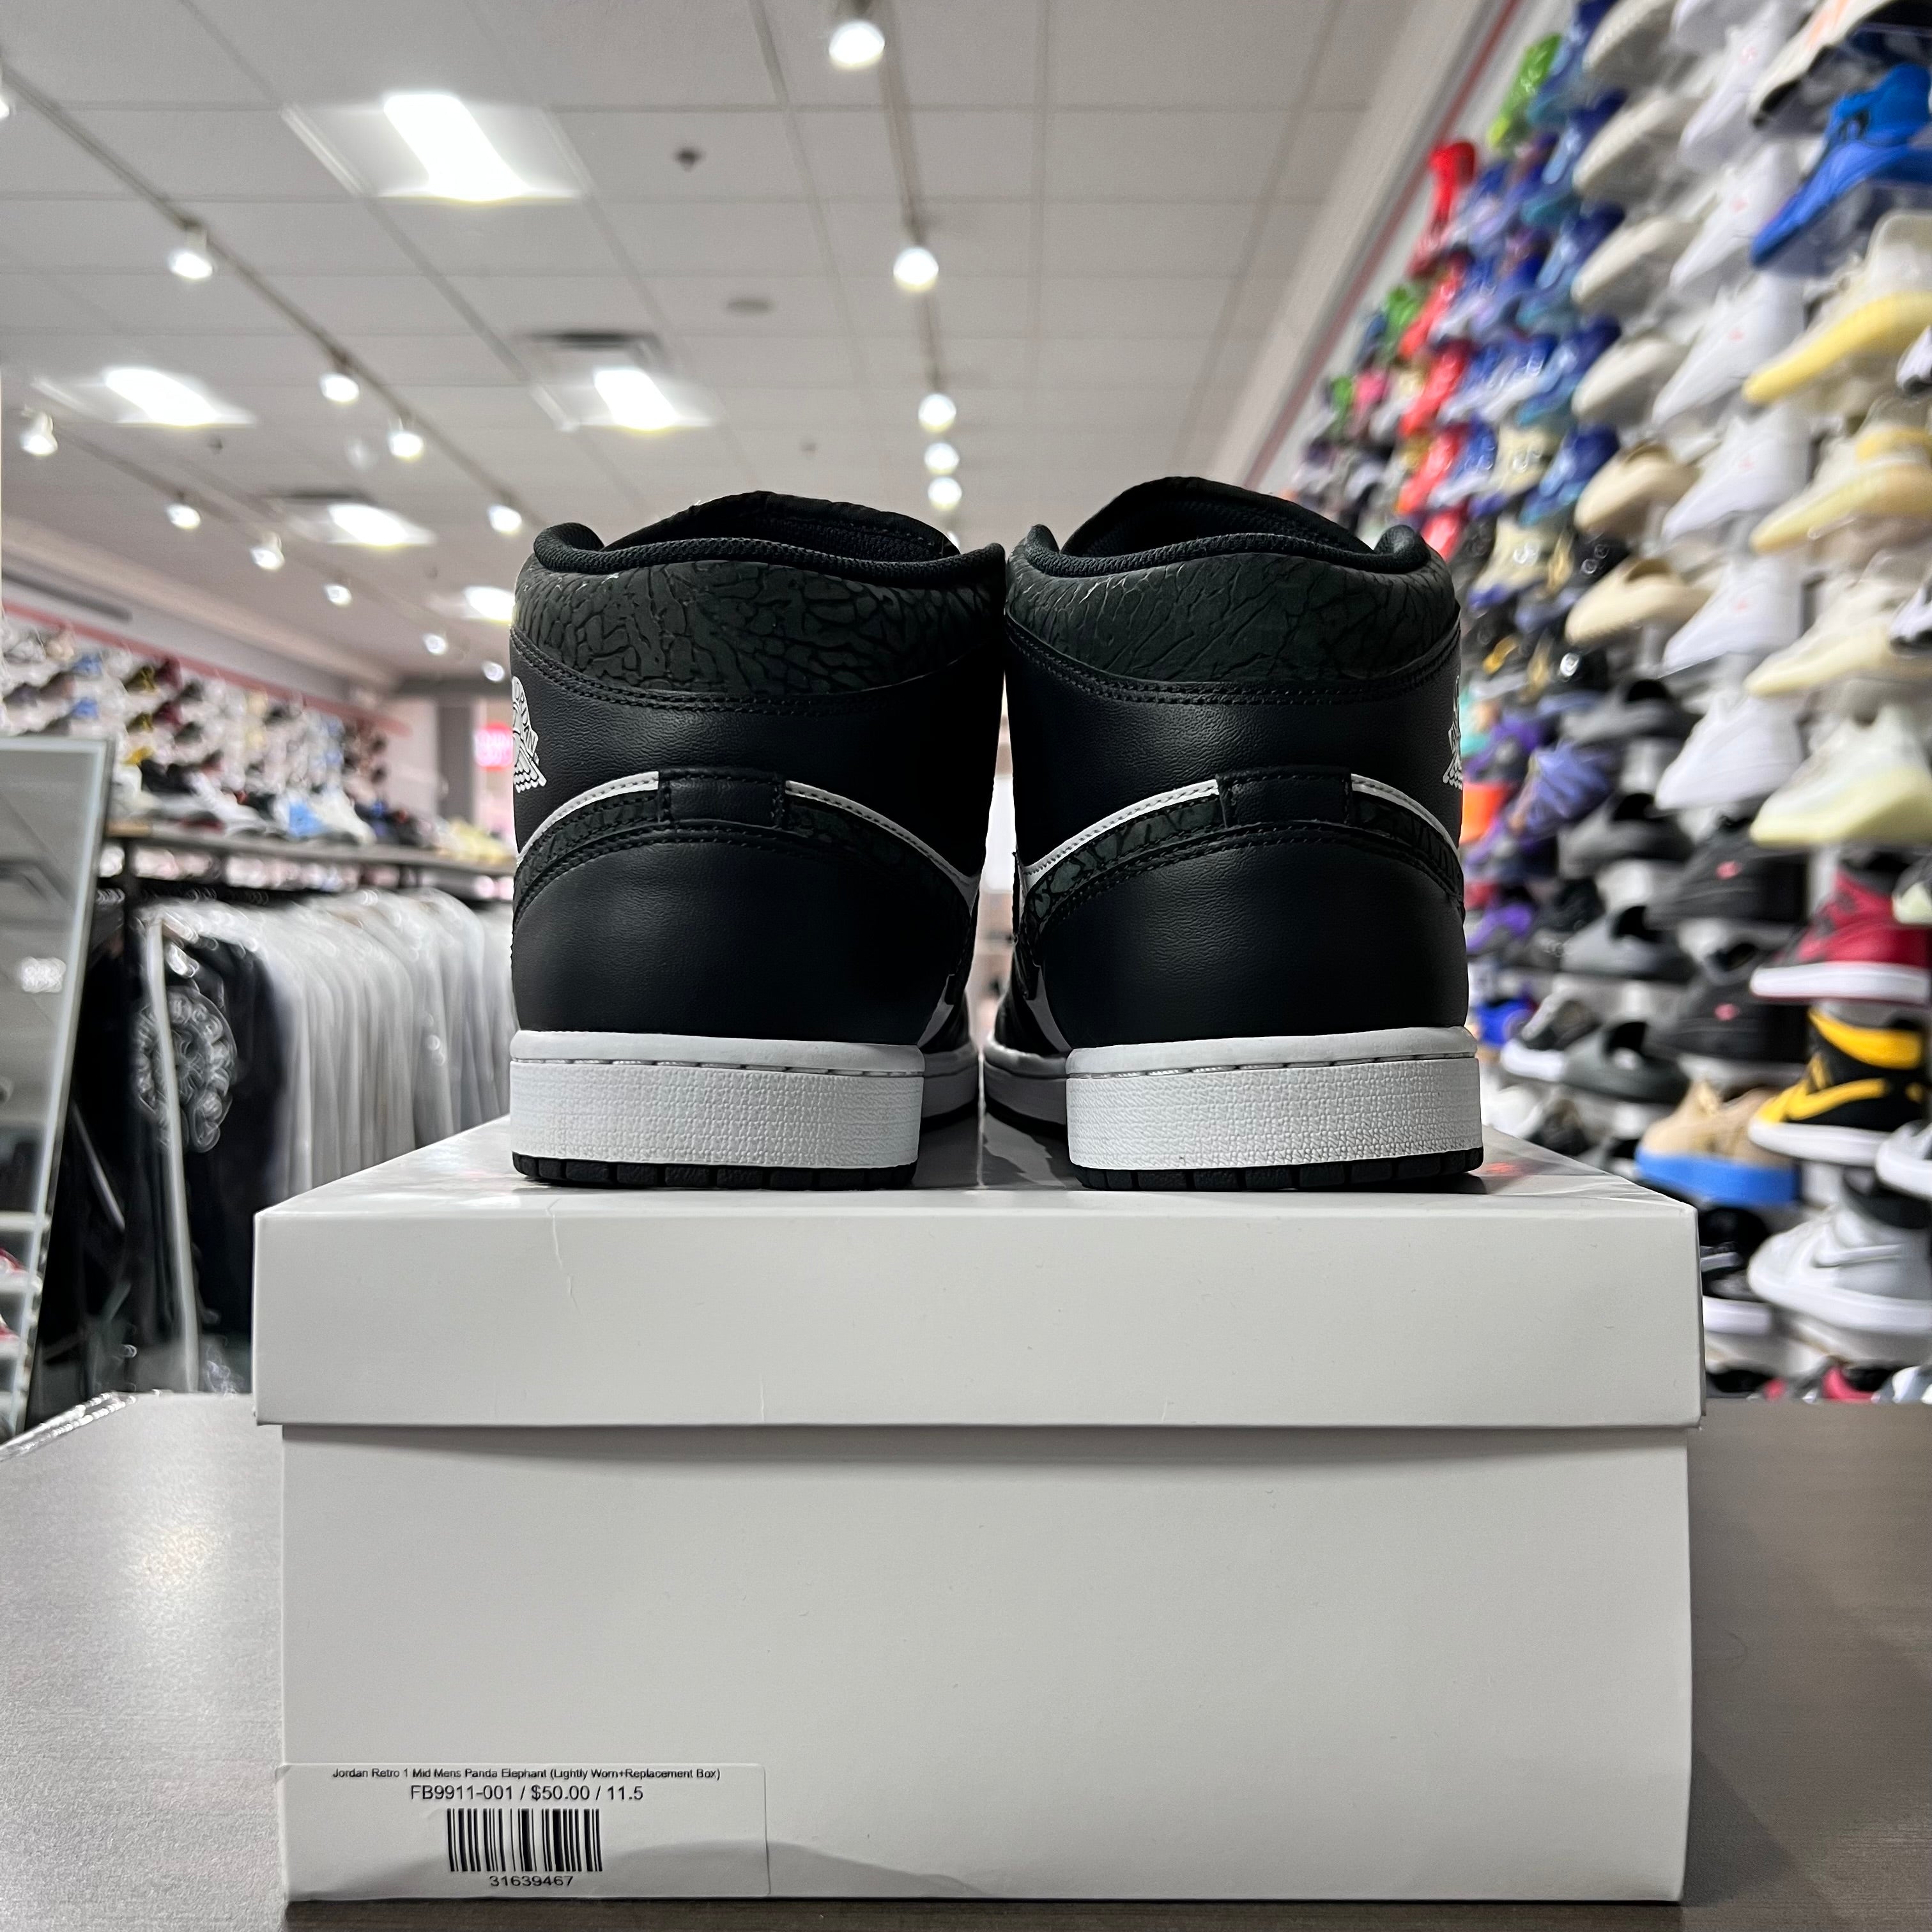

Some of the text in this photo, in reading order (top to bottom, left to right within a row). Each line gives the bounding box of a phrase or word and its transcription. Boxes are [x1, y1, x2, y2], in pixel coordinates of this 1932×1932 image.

[332, 1768, 721, 1781] Jordan Retro 1 Mid Mens Panda Elephant (Lightly Worn+Replacement Box)
[410, 1784, 644, 1802] FB9911-001 / $50.00 / 11.5
[489, 1875, 574, 1887] 31639467
